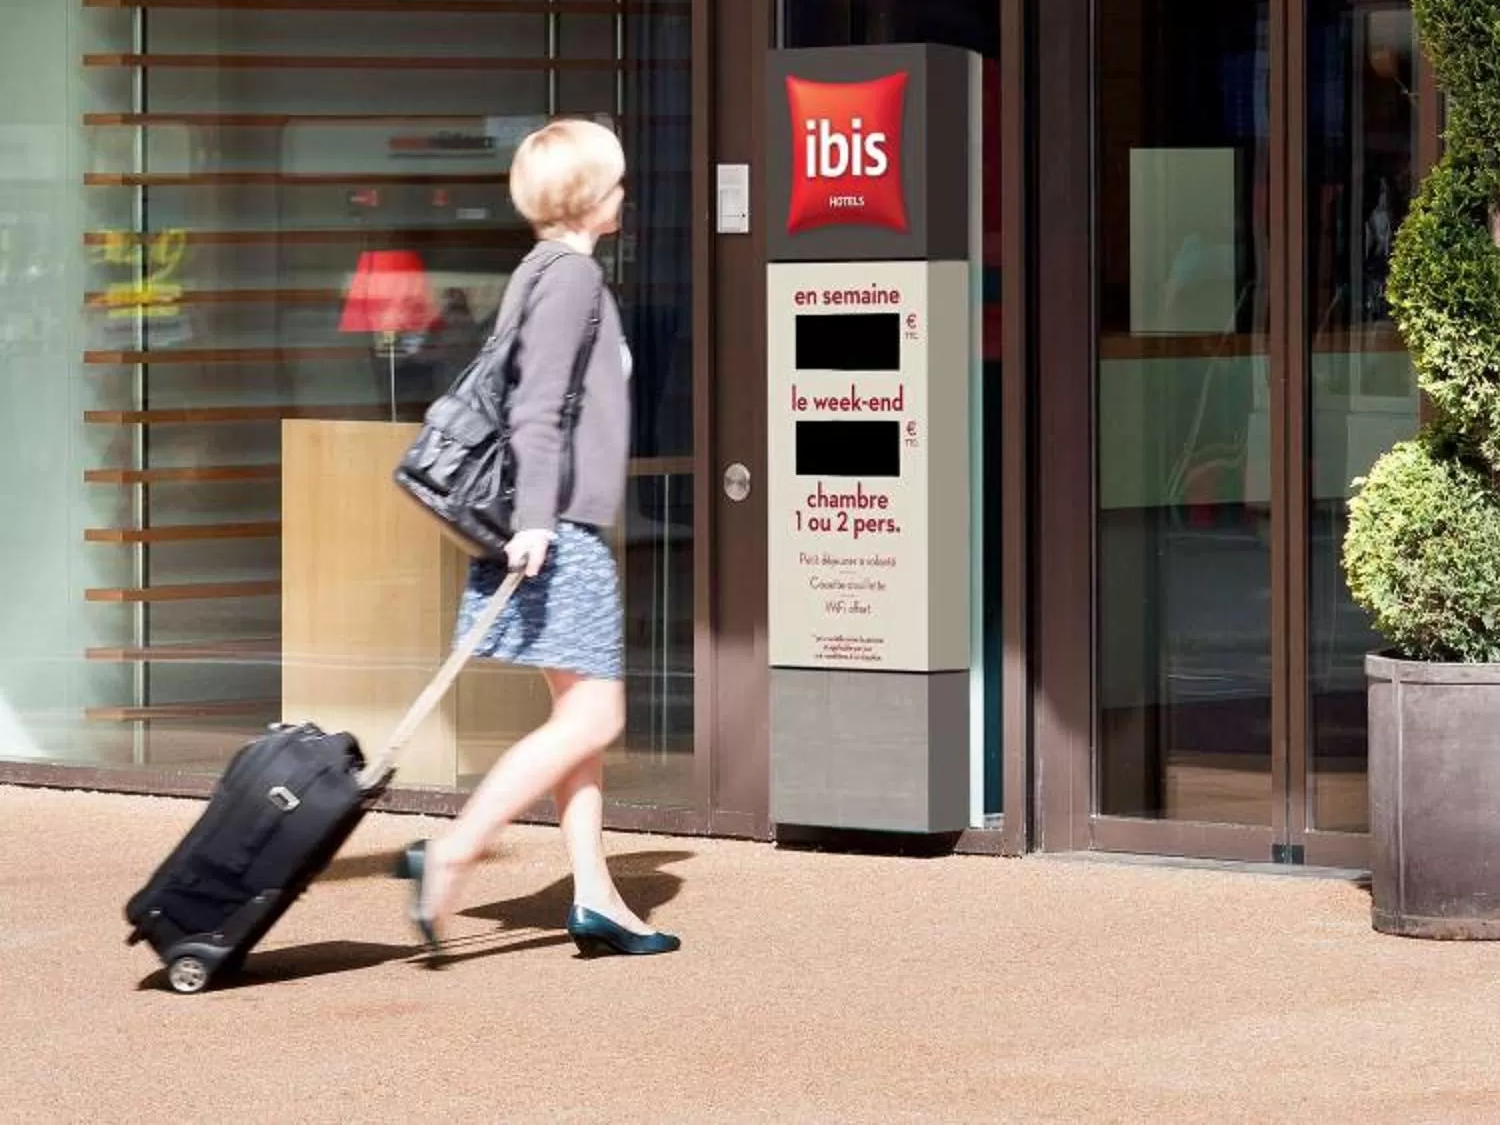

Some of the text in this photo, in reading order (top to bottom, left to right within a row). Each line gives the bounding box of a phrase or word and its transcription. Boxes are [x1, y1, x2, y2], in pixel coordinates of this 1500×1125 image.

[805, 118, 888, 178] ibis
[829, 195, 865, 208] HOTELS
[794, 283, 900, 305] en semaine
[905, 313, 917, 329] €
[791, 383, 904, 411] le week-end
[905, 421, 917, 437] €
[807, 481, 889, 509] chambre
[795, 510, 901, 539] 1 ou 2 pers.
